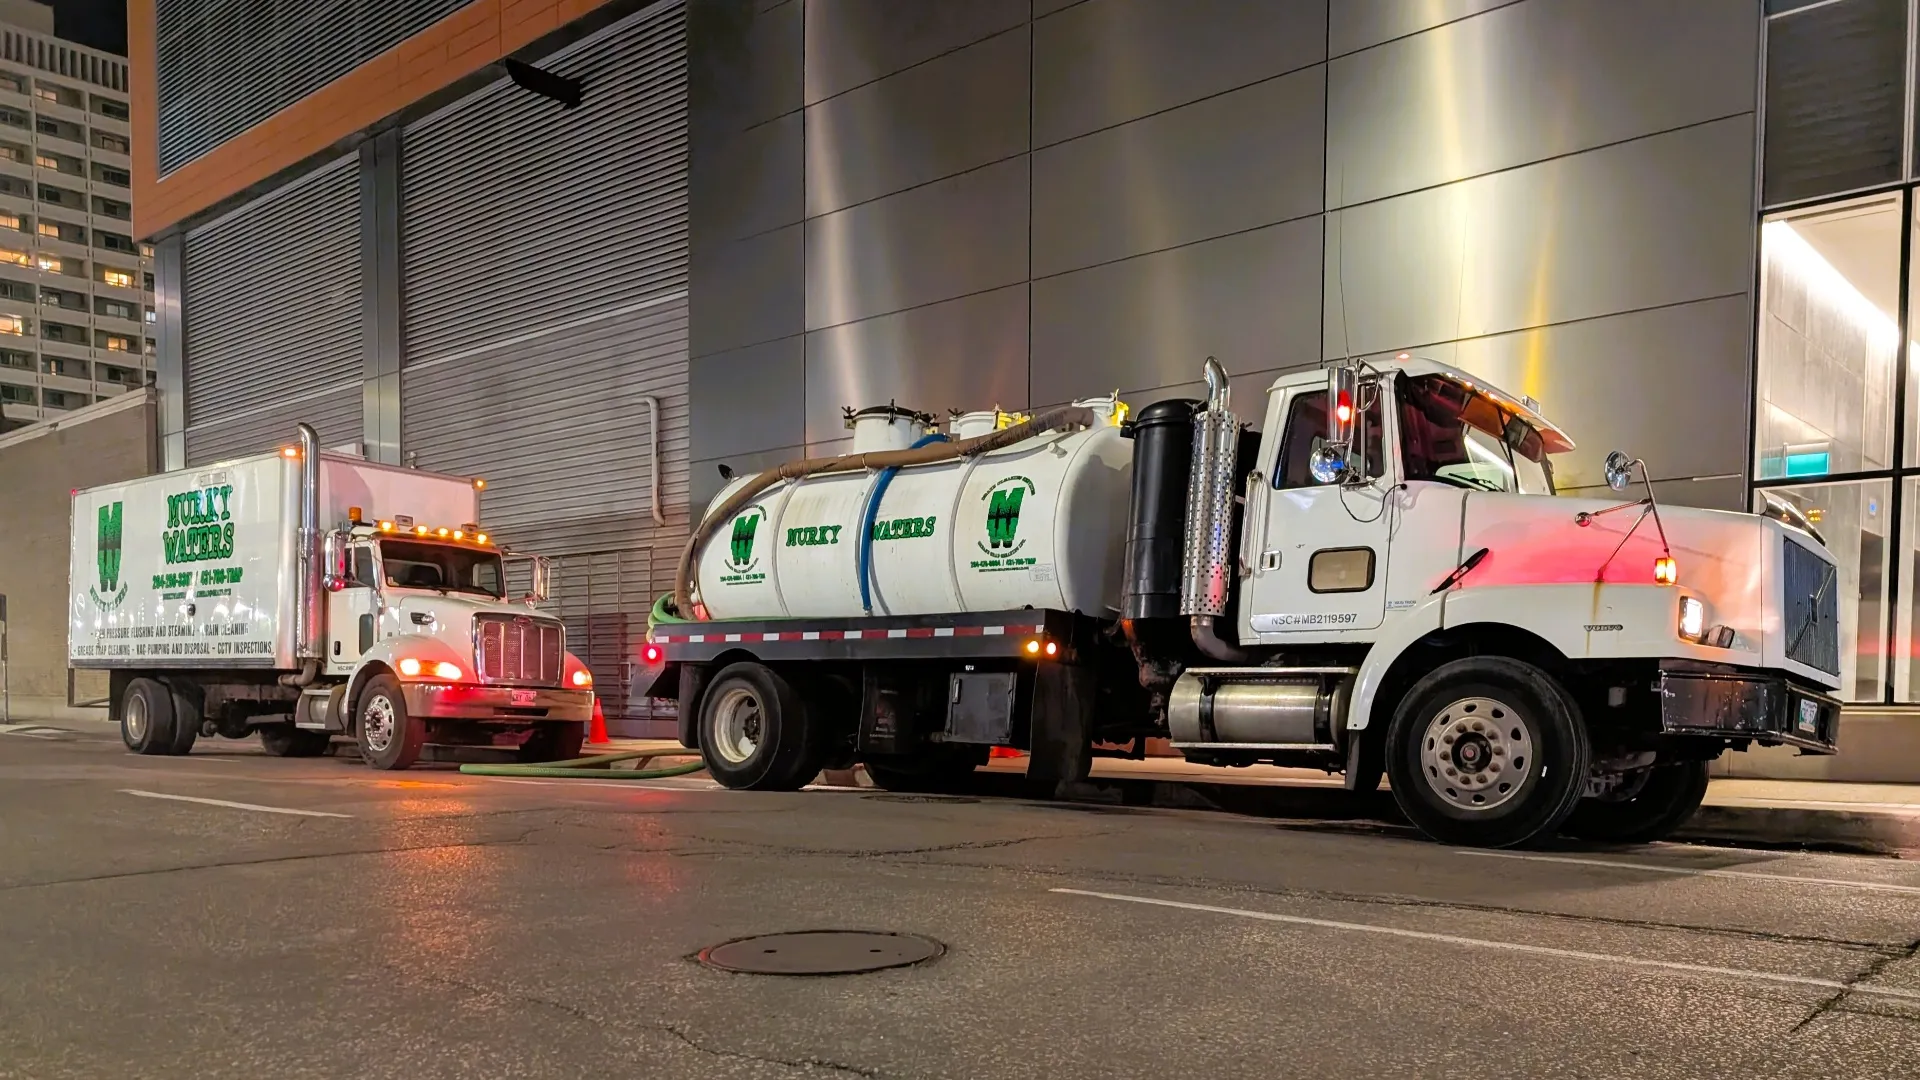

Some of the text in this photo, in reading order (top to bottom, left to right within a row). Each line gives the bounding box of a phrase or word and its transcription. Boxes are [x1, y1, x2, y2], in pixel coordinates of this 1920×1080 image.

[167, 485, 233, 528] MURKY
[786, 516, 936, 547] MURKY WATERS
[163, 522, 234, 565] WATERS
[1271, 613, 1357, 626] NSC#MB2119597
[107, 627, 129, 639] PRESSURE
[131, 626, 154, 638] FLUSHING
[155, 625, 166, 637] AND
[1583, 624, 1623, 632] VOLVO
[78, 645, 94, 656] GREASE
[95, 644, 107, 656] TRAP
[108, 644, 130, 656] CLEANING
[148, 643, 170, 655] PUMPING
[171, 643, 182, 655] AND
[184, 642, 210, 655] DISPOSAL
[217, 642, 231, 655] CCTV
[234, 640, 272, 654] INSPECTIONS
